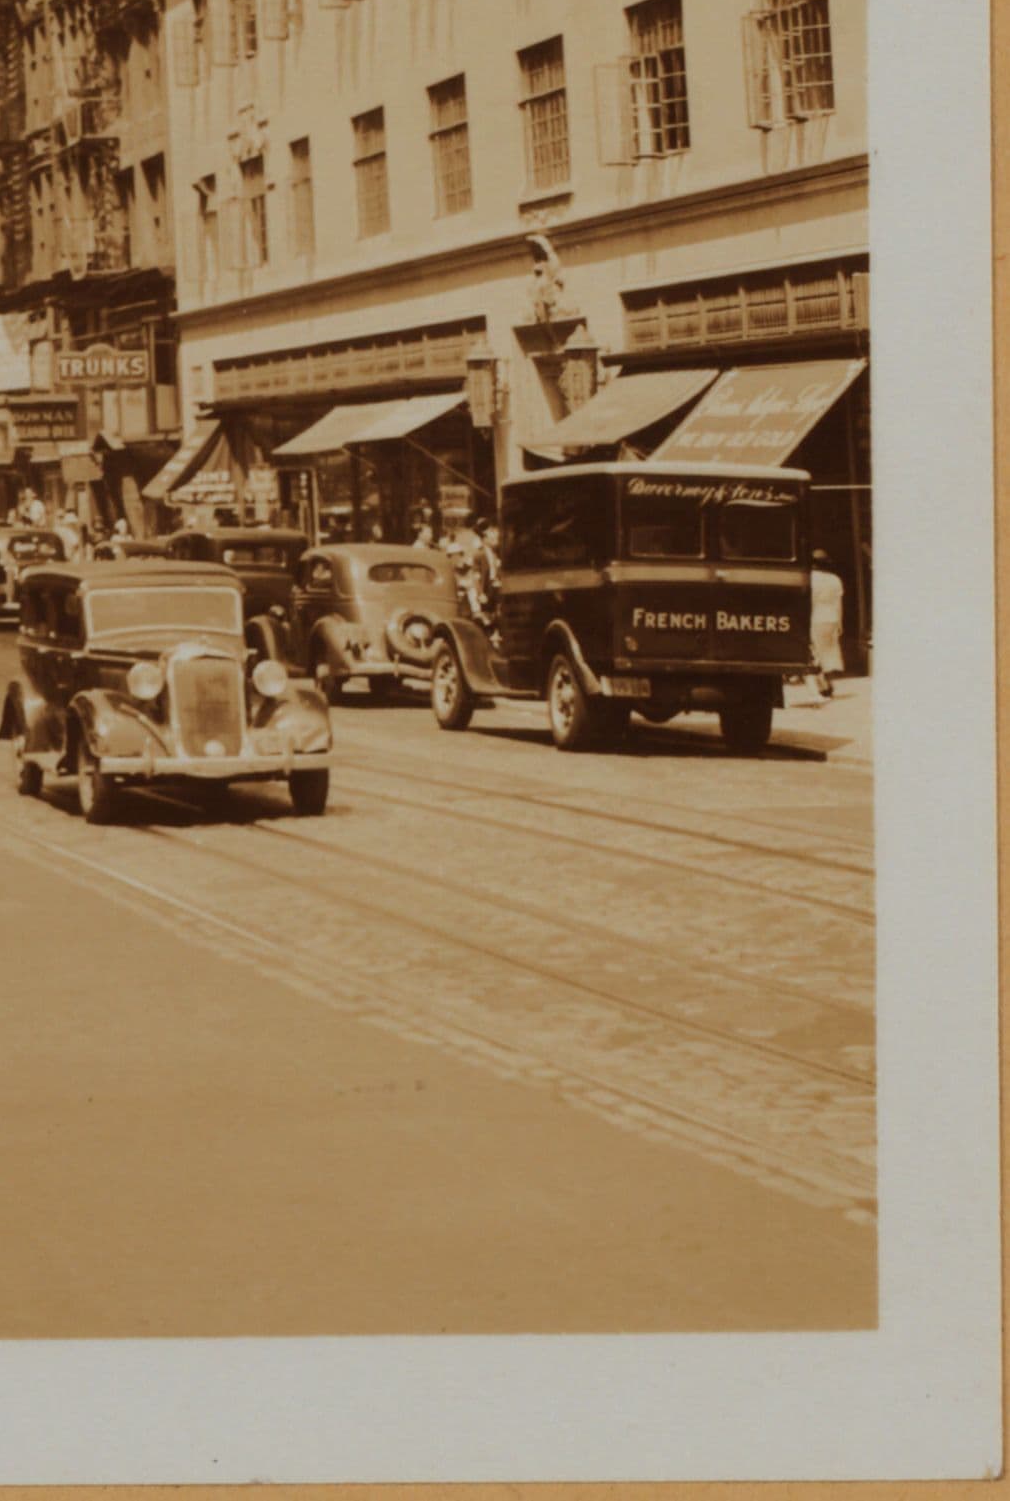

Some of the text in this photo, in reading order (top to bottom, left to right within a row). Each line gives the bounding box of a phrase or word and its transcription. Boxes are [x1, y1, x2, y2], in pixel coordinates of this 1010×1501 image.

[60, 357, 145, 377] TRUNKS
[632, 607, 791, 632] FRENCH BAKERS
